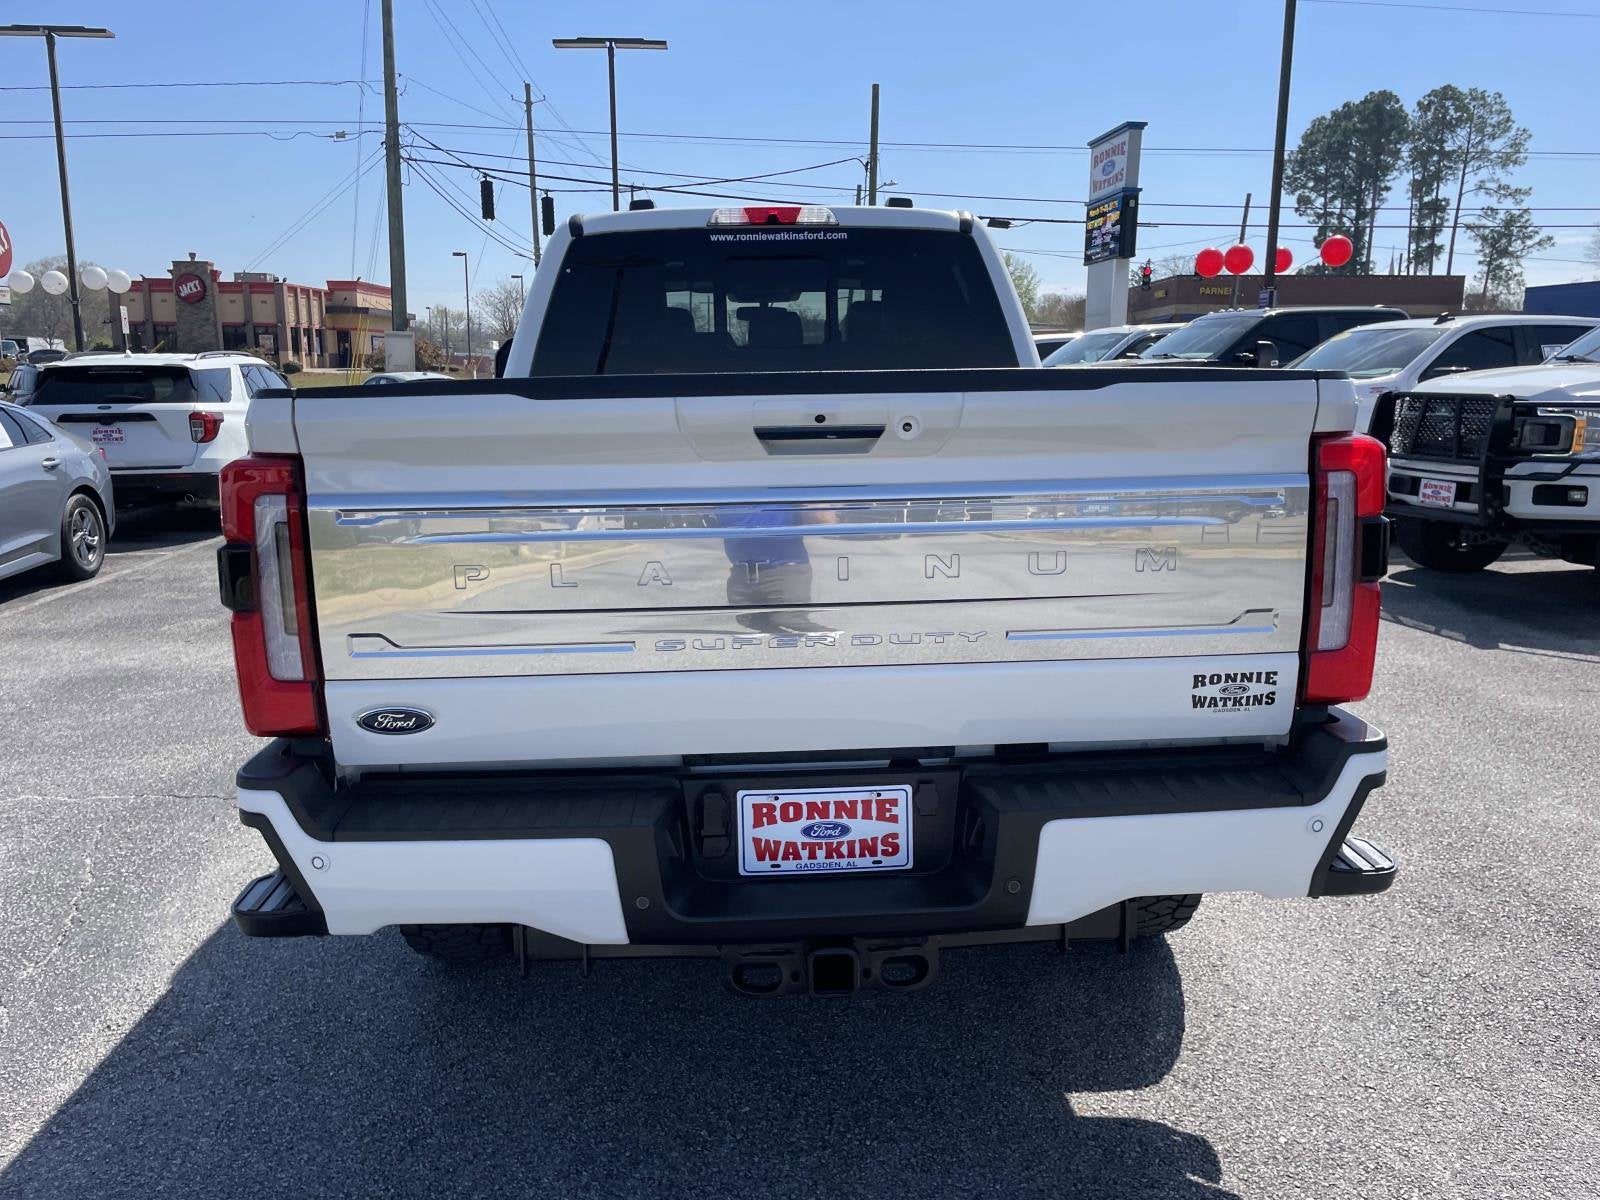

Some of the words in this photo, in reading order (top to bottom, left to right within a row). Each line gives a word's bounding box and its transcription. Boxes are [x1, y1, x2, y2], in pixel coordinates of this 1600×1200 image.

[1093, 141, 1126, 169] RONNIE
[1092, 168, 1125, 193] WATKINS
[710, 231, 848, 241] www.ronniewatkinsford.com
[453, 546, 1178, 590] PLATINUM
[654, 634, 836, 652] SUPER
[850, 631, 988, 647] DUTY
[1192, 671, 1278, 689] RONNIE
[1191, 691, 1277, 709] WATKINS
[374, 713, 417, 729] Ford
[751, 798, 899, 829] RONNIE
[810, 823, 842, 837] Ford
[751, 832, 901, 862] WATKINS
[795, 861, 844, 870] GADSDEN,
[845, 860, 858, 868] AL
